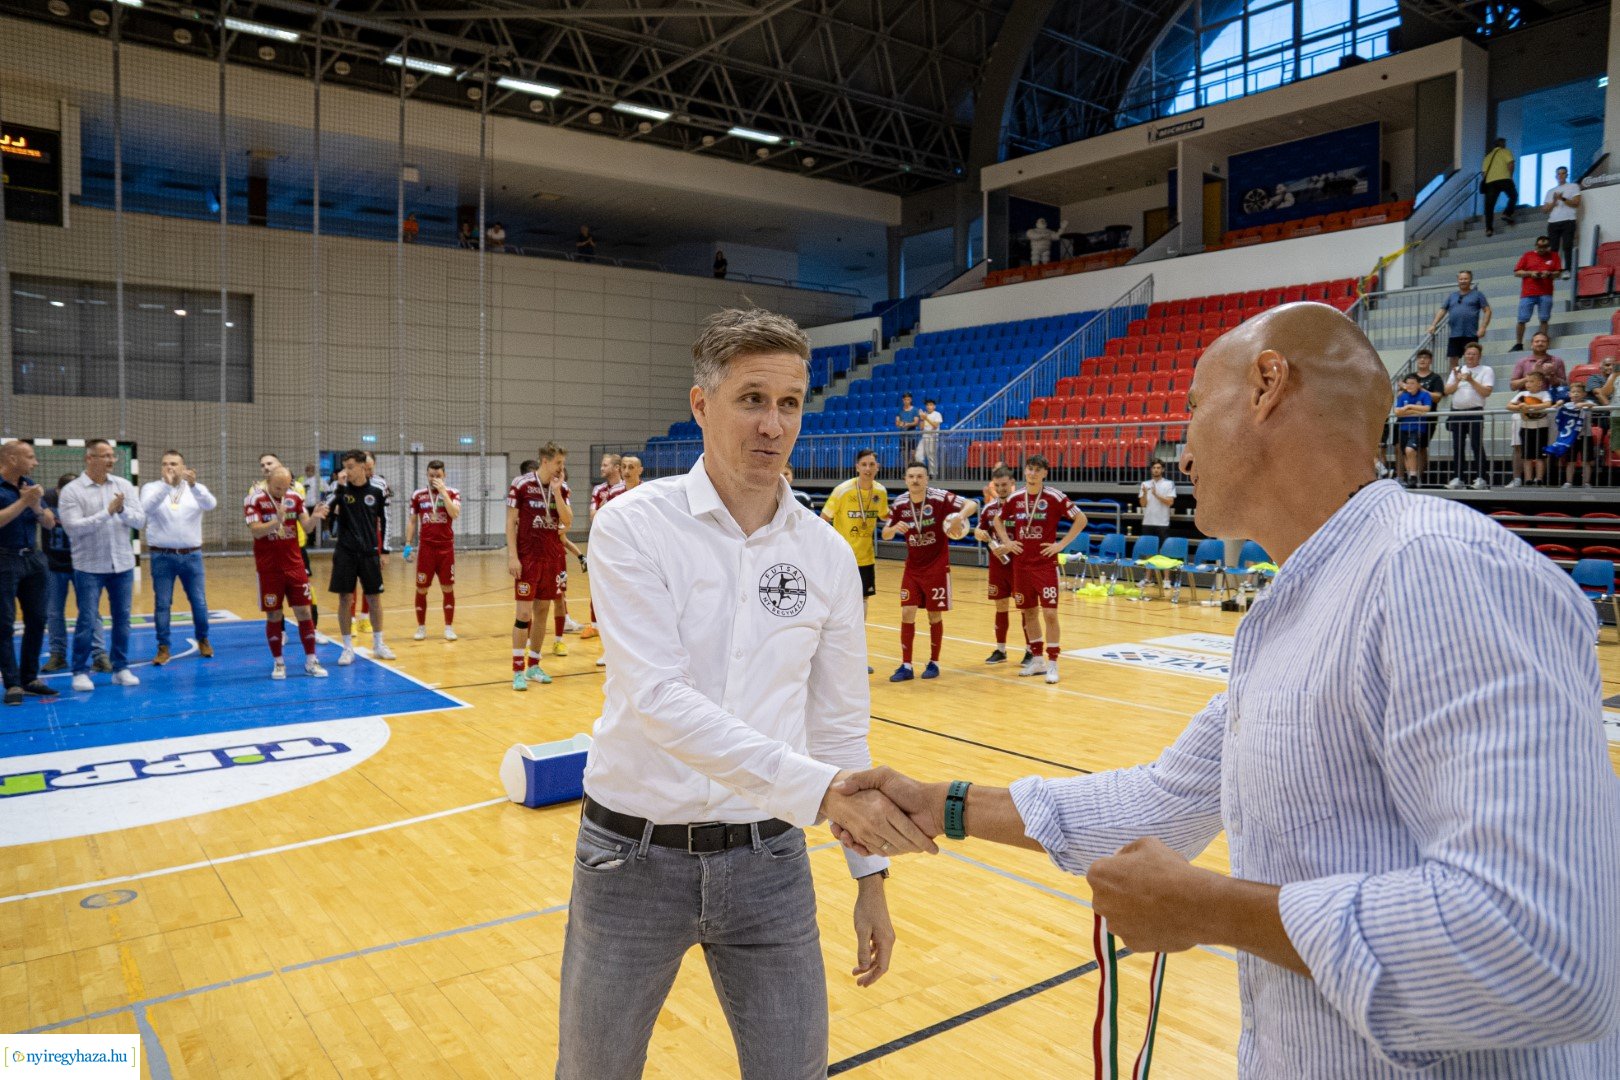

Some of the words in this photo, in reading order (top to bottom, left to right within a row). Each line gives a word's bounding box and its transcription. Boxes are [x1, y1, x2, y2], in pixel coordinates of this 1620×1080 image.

[765, 567, 802, 581] FUTSAL
[931, 587, 946, 600] 22
[1042, 586, 1057, 599] 88
